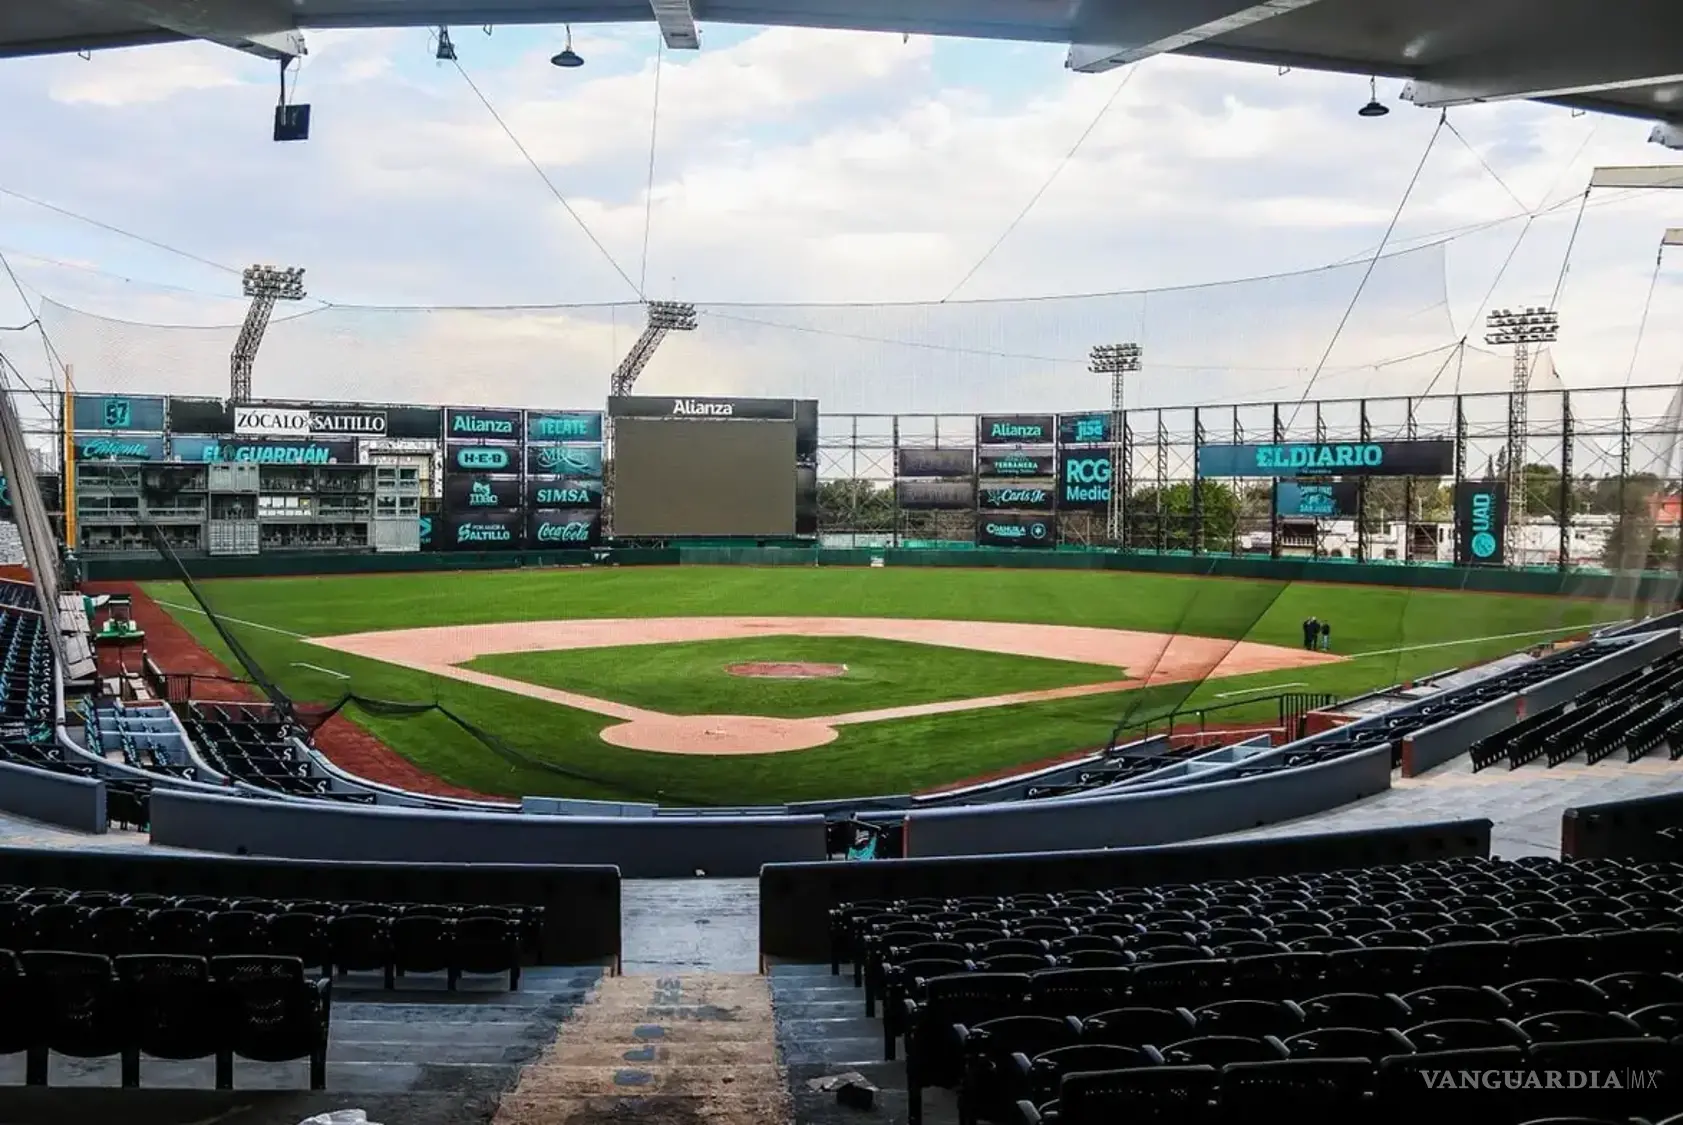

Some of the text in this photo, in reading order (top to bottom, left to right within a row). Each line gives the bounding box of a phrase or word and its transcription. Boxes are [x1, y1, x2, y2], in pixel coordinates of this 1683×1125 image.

[673, 399, 733, 415] Alianza
[237, 410, 386, 431] ZÓCALO SALTILLO
[453, 415, 513, 433] Alianza
[540, 419, 588, 435] TECATE
[991, 423, 1042, 437] Alianza
[202, 444, 330, 463] EL GUARDIÁN
[1066, 458, 1110, 483] RCG
[536, 489, 590, 503] SIMSA
[1472, 494, 1490, 532] UAD
